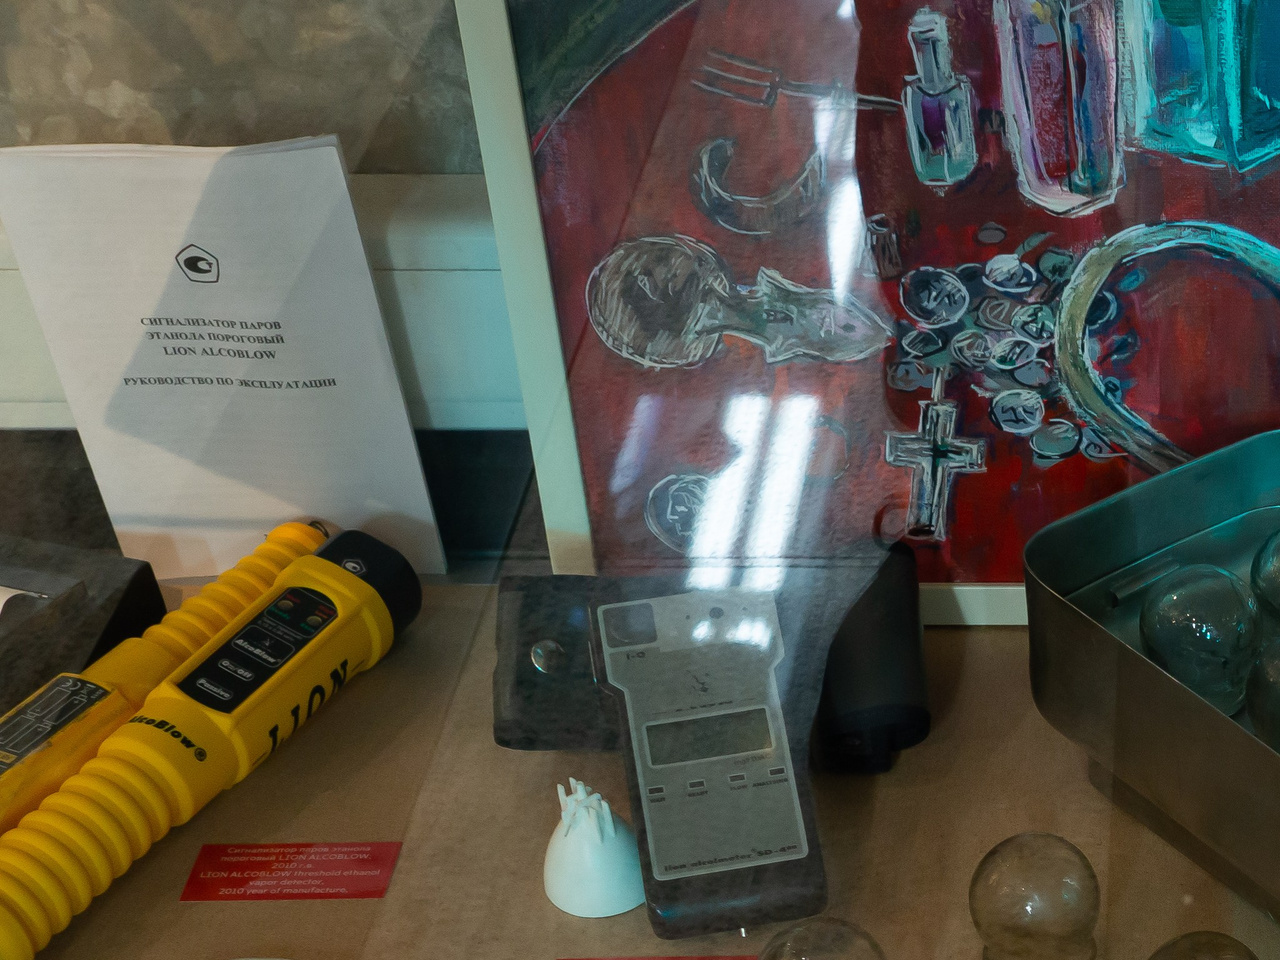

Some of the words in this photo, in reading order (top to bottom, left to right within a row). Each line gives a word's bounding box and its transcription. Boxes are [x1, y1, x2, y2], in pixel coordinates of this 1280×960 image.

[140, 317, 237, 329] СИГНАЛИЗАТОР
[240, 320, 282, 331] ПАРОВ
[146, 331, 205, 341] ЭТАНОЛА
[207, 331, 286, 345] ПОРОГОВЫЙ
[163, 346, 197, 356] LION
[201, 347, 277, 360] ALCOBLOW
[123, 376, 214, 387] РУКОВОДСТВО
[216, 376, 234, 387] ПО
[237, 378, 338, 390] ЭКСПЛУАТАЦИИ
[343, 869, 381, 877] ethanol
[245, 887, 269, 896] year
